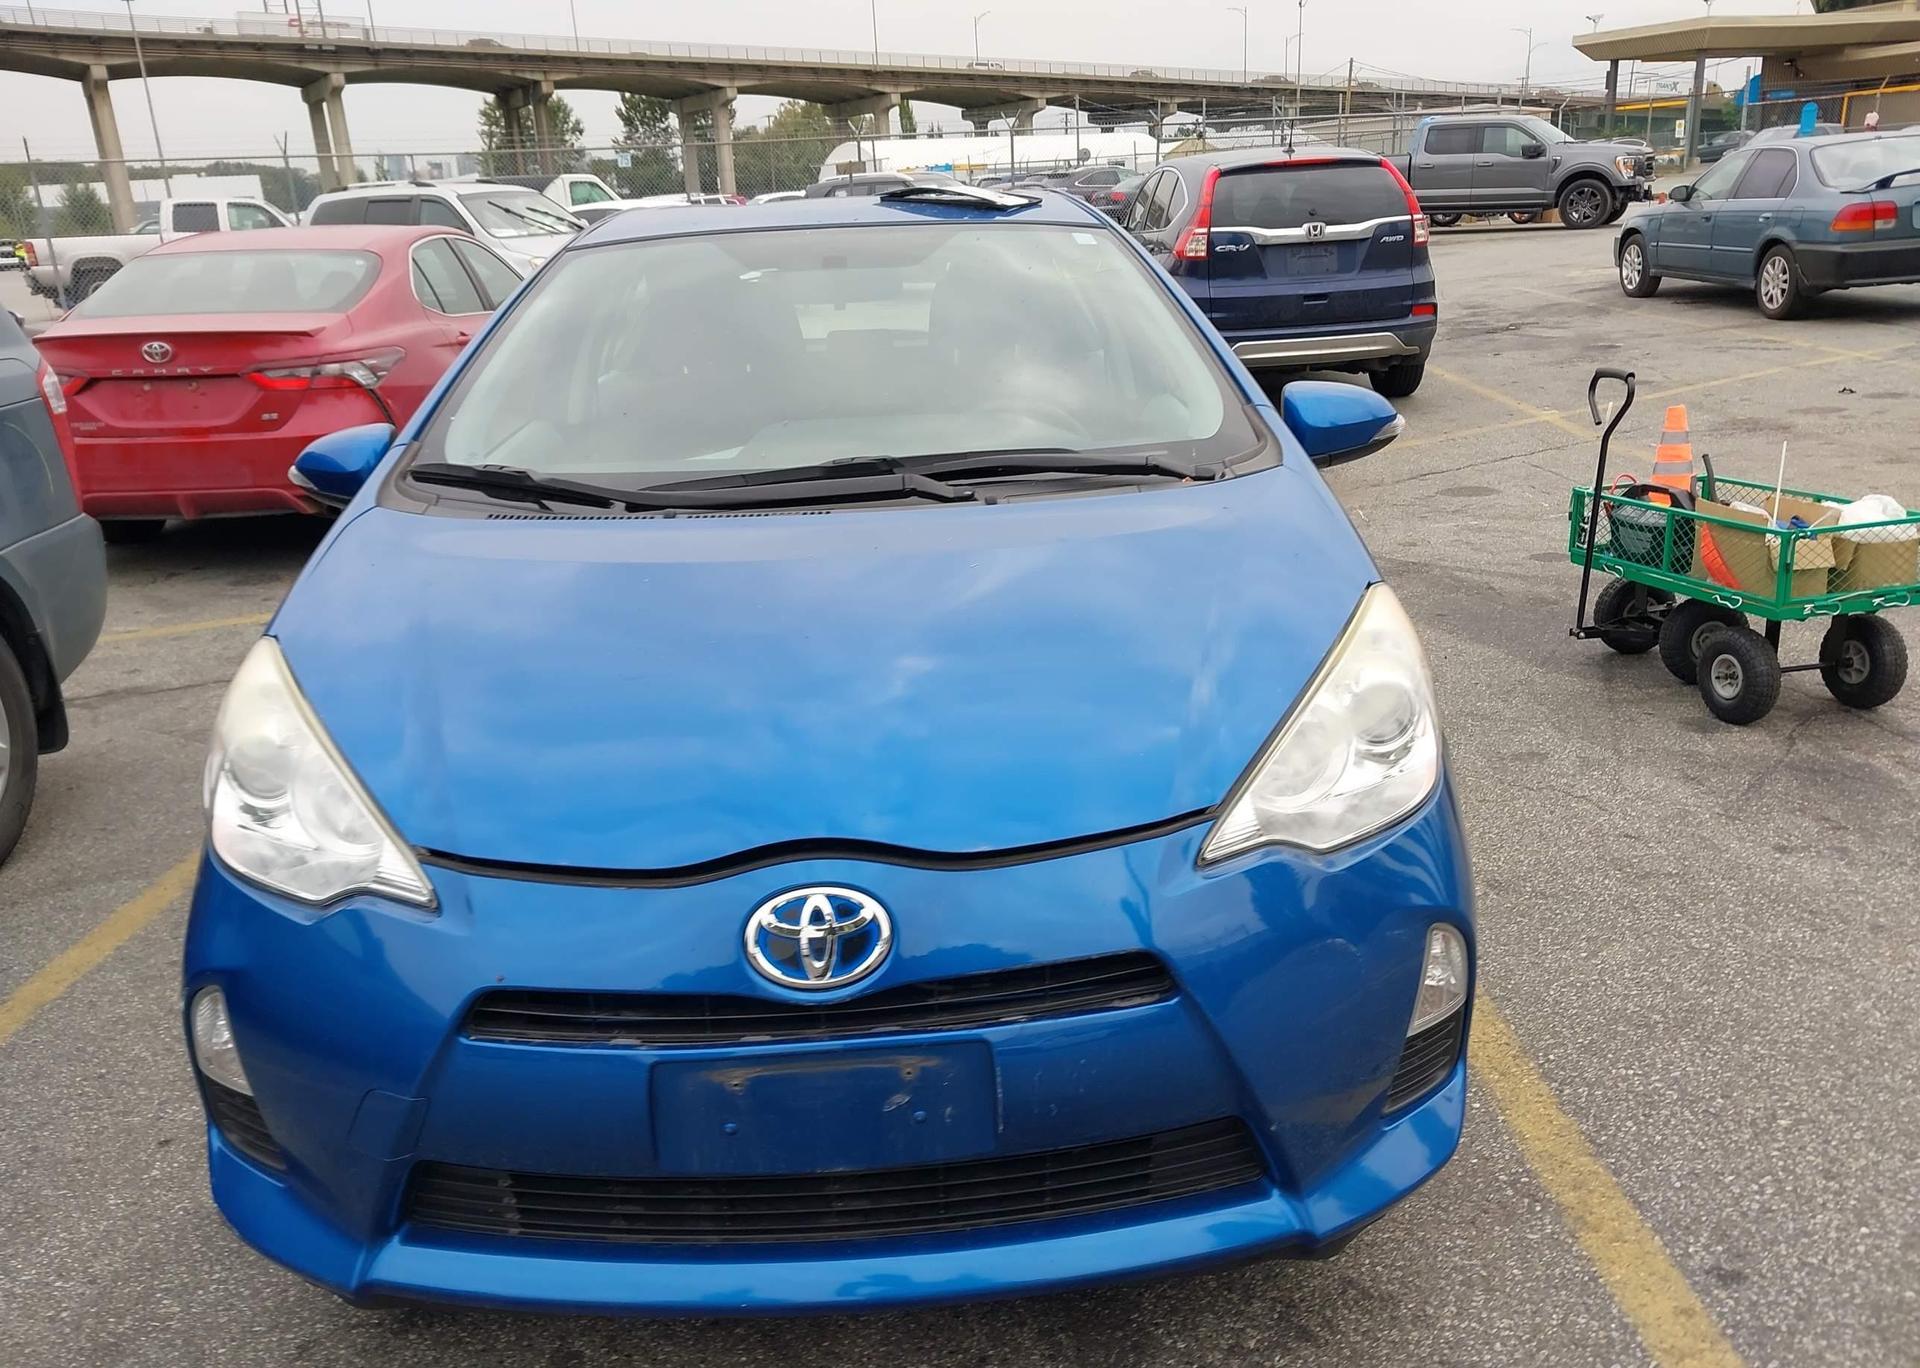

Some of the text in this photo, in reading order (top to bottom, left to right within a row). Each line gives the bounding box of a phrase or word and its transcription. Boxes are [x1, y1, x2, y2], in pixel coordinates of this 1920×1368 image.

[1380, 235, 1404, 243] AWD
[1214, 244, 1250, 253] CR-V
[111, 367, 212, 376] CAMRY
